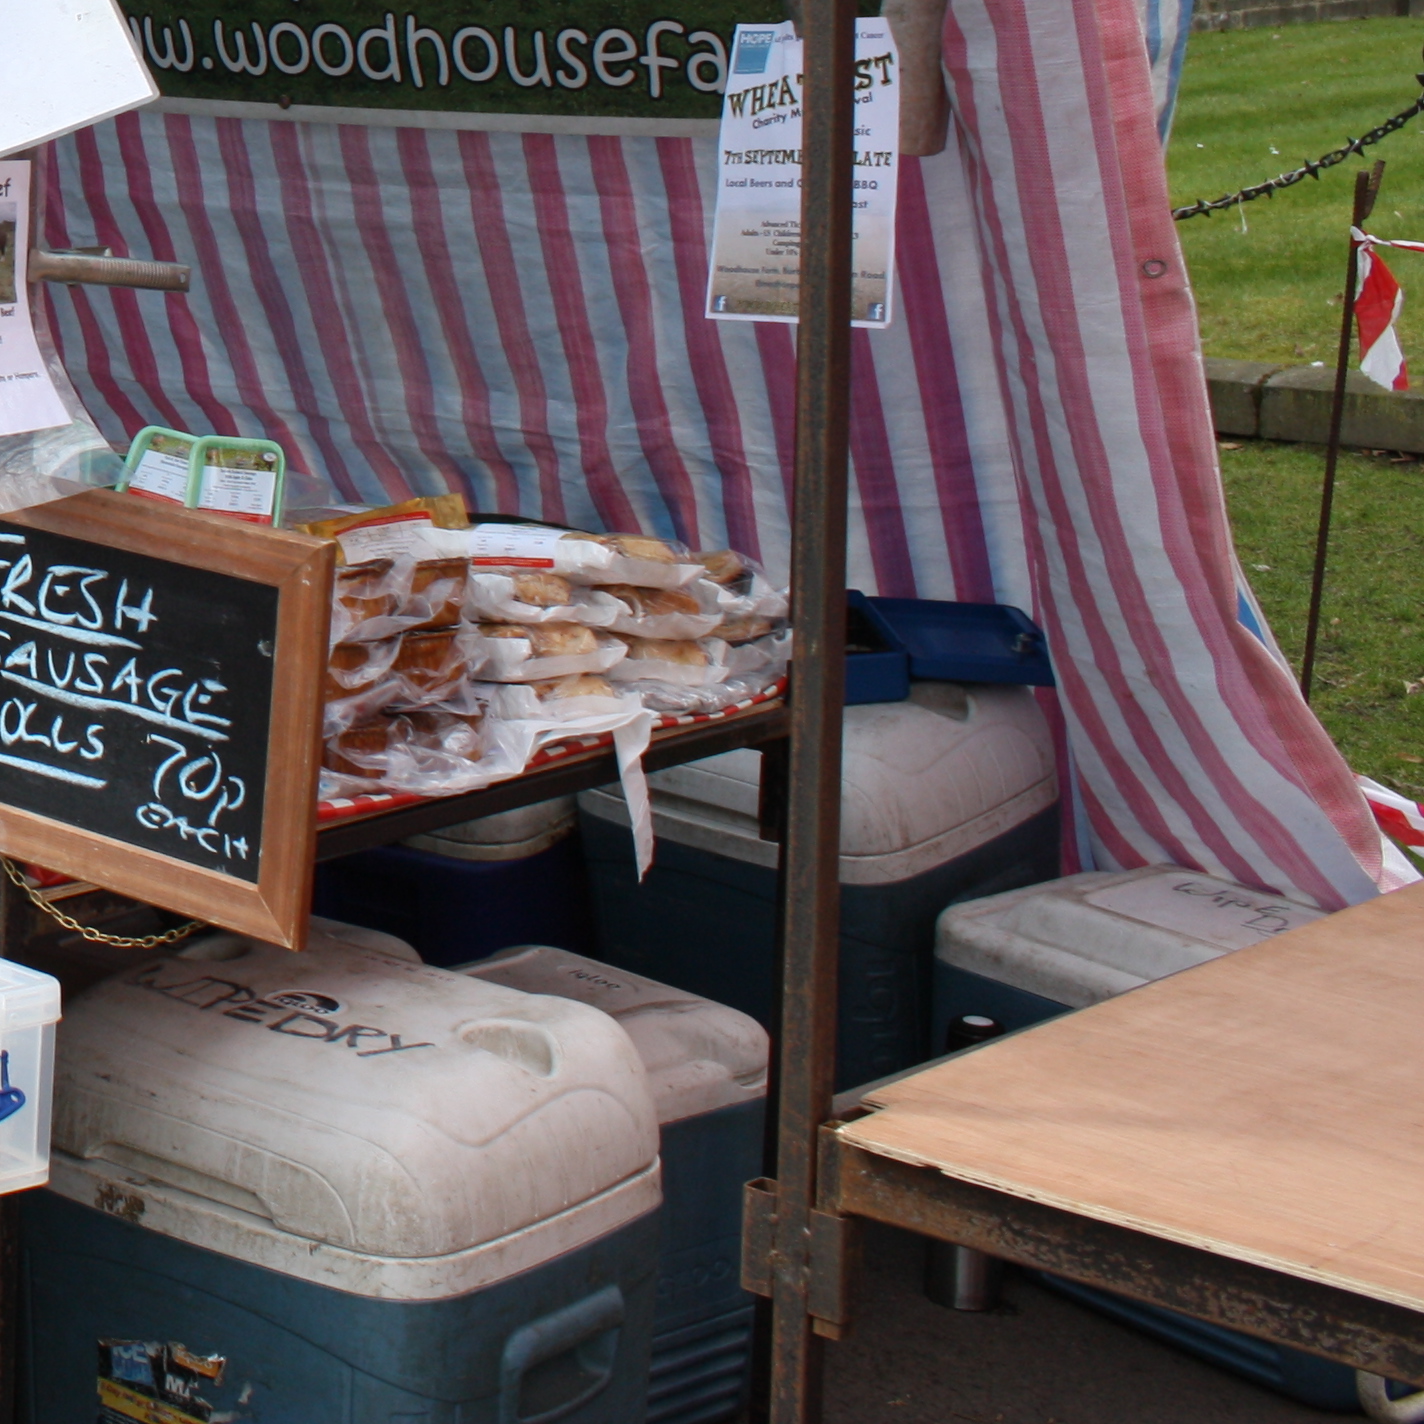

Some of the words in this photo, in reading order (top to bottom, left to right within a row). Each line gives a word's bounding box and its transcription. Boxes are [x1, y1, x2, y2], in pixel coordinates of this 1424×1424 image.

[741, 33, 772, 44] HOPE
[752, 114, 787, 129] Charity
[726, 178, 747, 187] Local
[750, 179, 773, 188] Beers
[775, 178, 793, 188] and
[0, 307, 15, 317] Beef
[278, 996, 330, 1015] IGLOO
[267, 1012, 436, 1058] DRY
